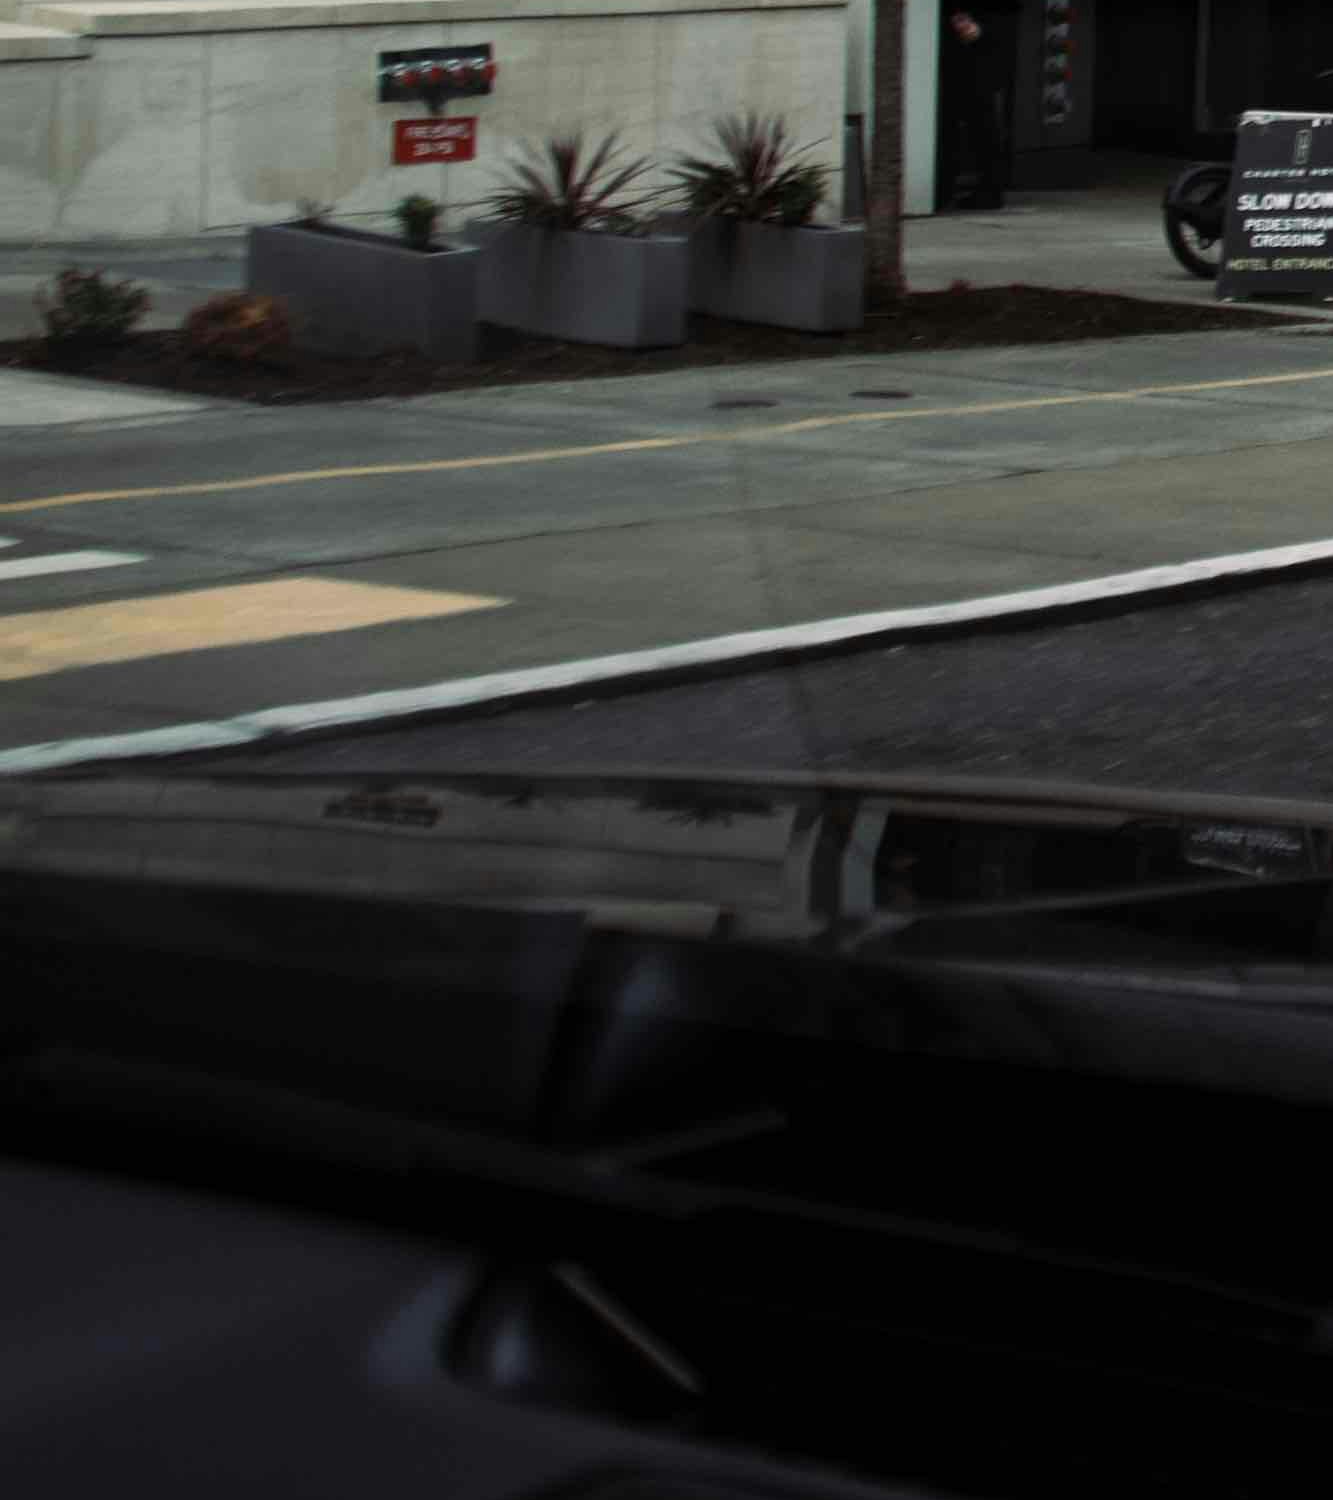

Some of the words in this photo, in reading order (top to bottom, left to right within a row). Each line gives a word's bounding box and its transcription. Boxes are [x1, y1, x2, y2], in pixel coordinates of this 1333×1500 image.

[1236, 193, 1292, 211] SLOW
[1250, 233, 1327, 247] CROSSING
[1226, 258, 1268, 271] HOTEL
